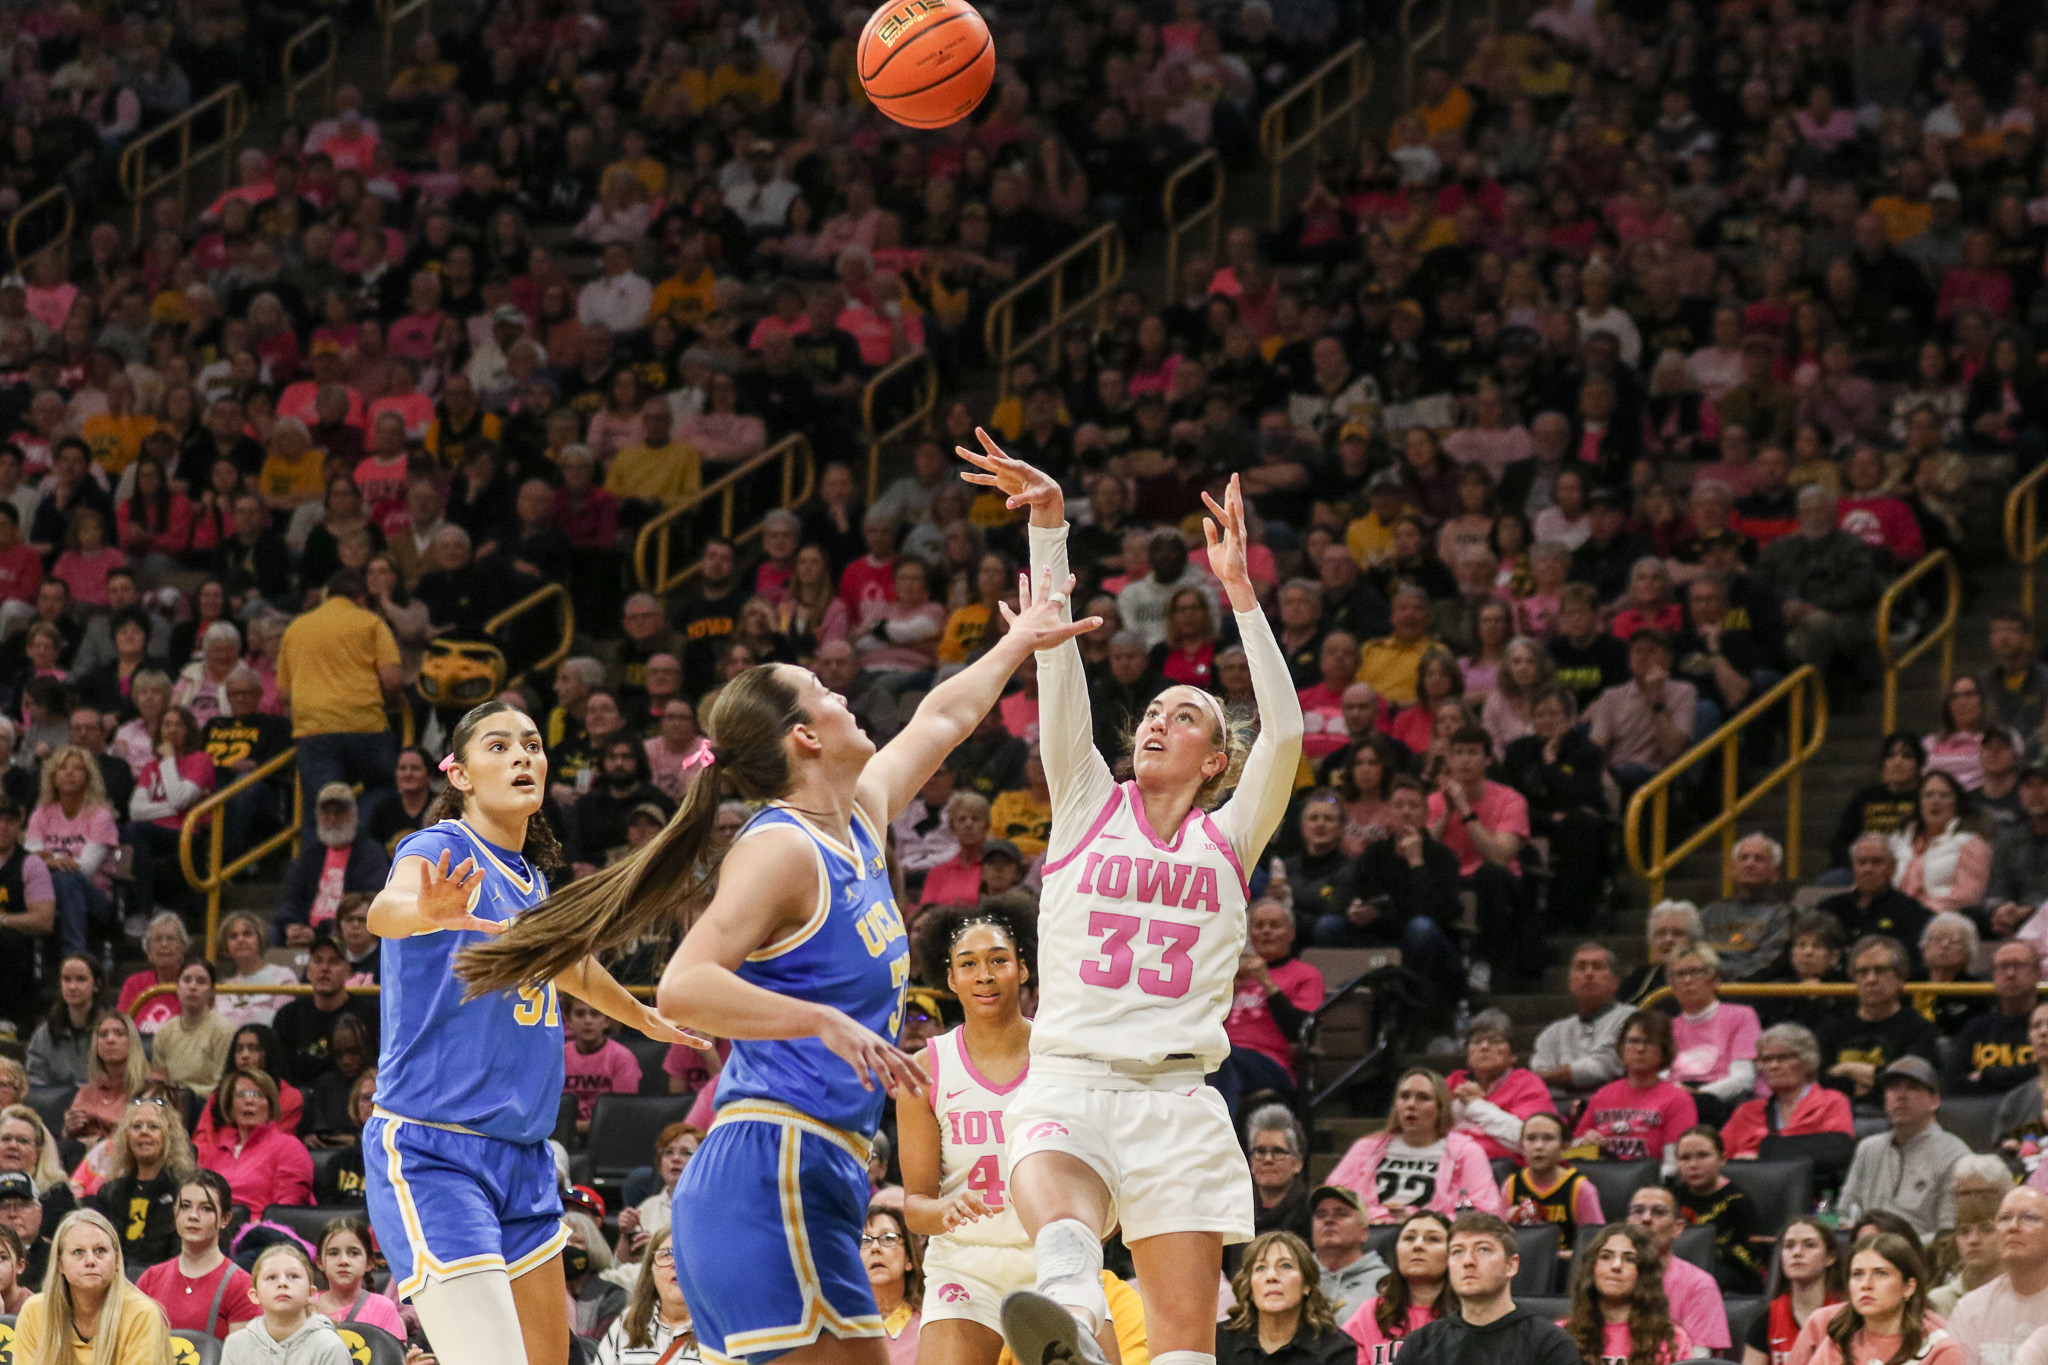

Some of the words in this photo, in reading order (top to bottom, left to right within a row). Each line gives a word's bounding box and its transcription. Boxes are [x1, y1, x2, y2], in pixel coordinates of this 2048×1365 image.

[1077, 852, 1221, 913] IOWA
[855, 898, 907, 958] UCL
[1079, 911, 1200, 999] 33
[513, 979, 560, 1028] 51
[565, 1074, 612, 1090] OWA
[948, 1110, 1005, 1145] IO
[969, 1154, 1005, 1206] 4
